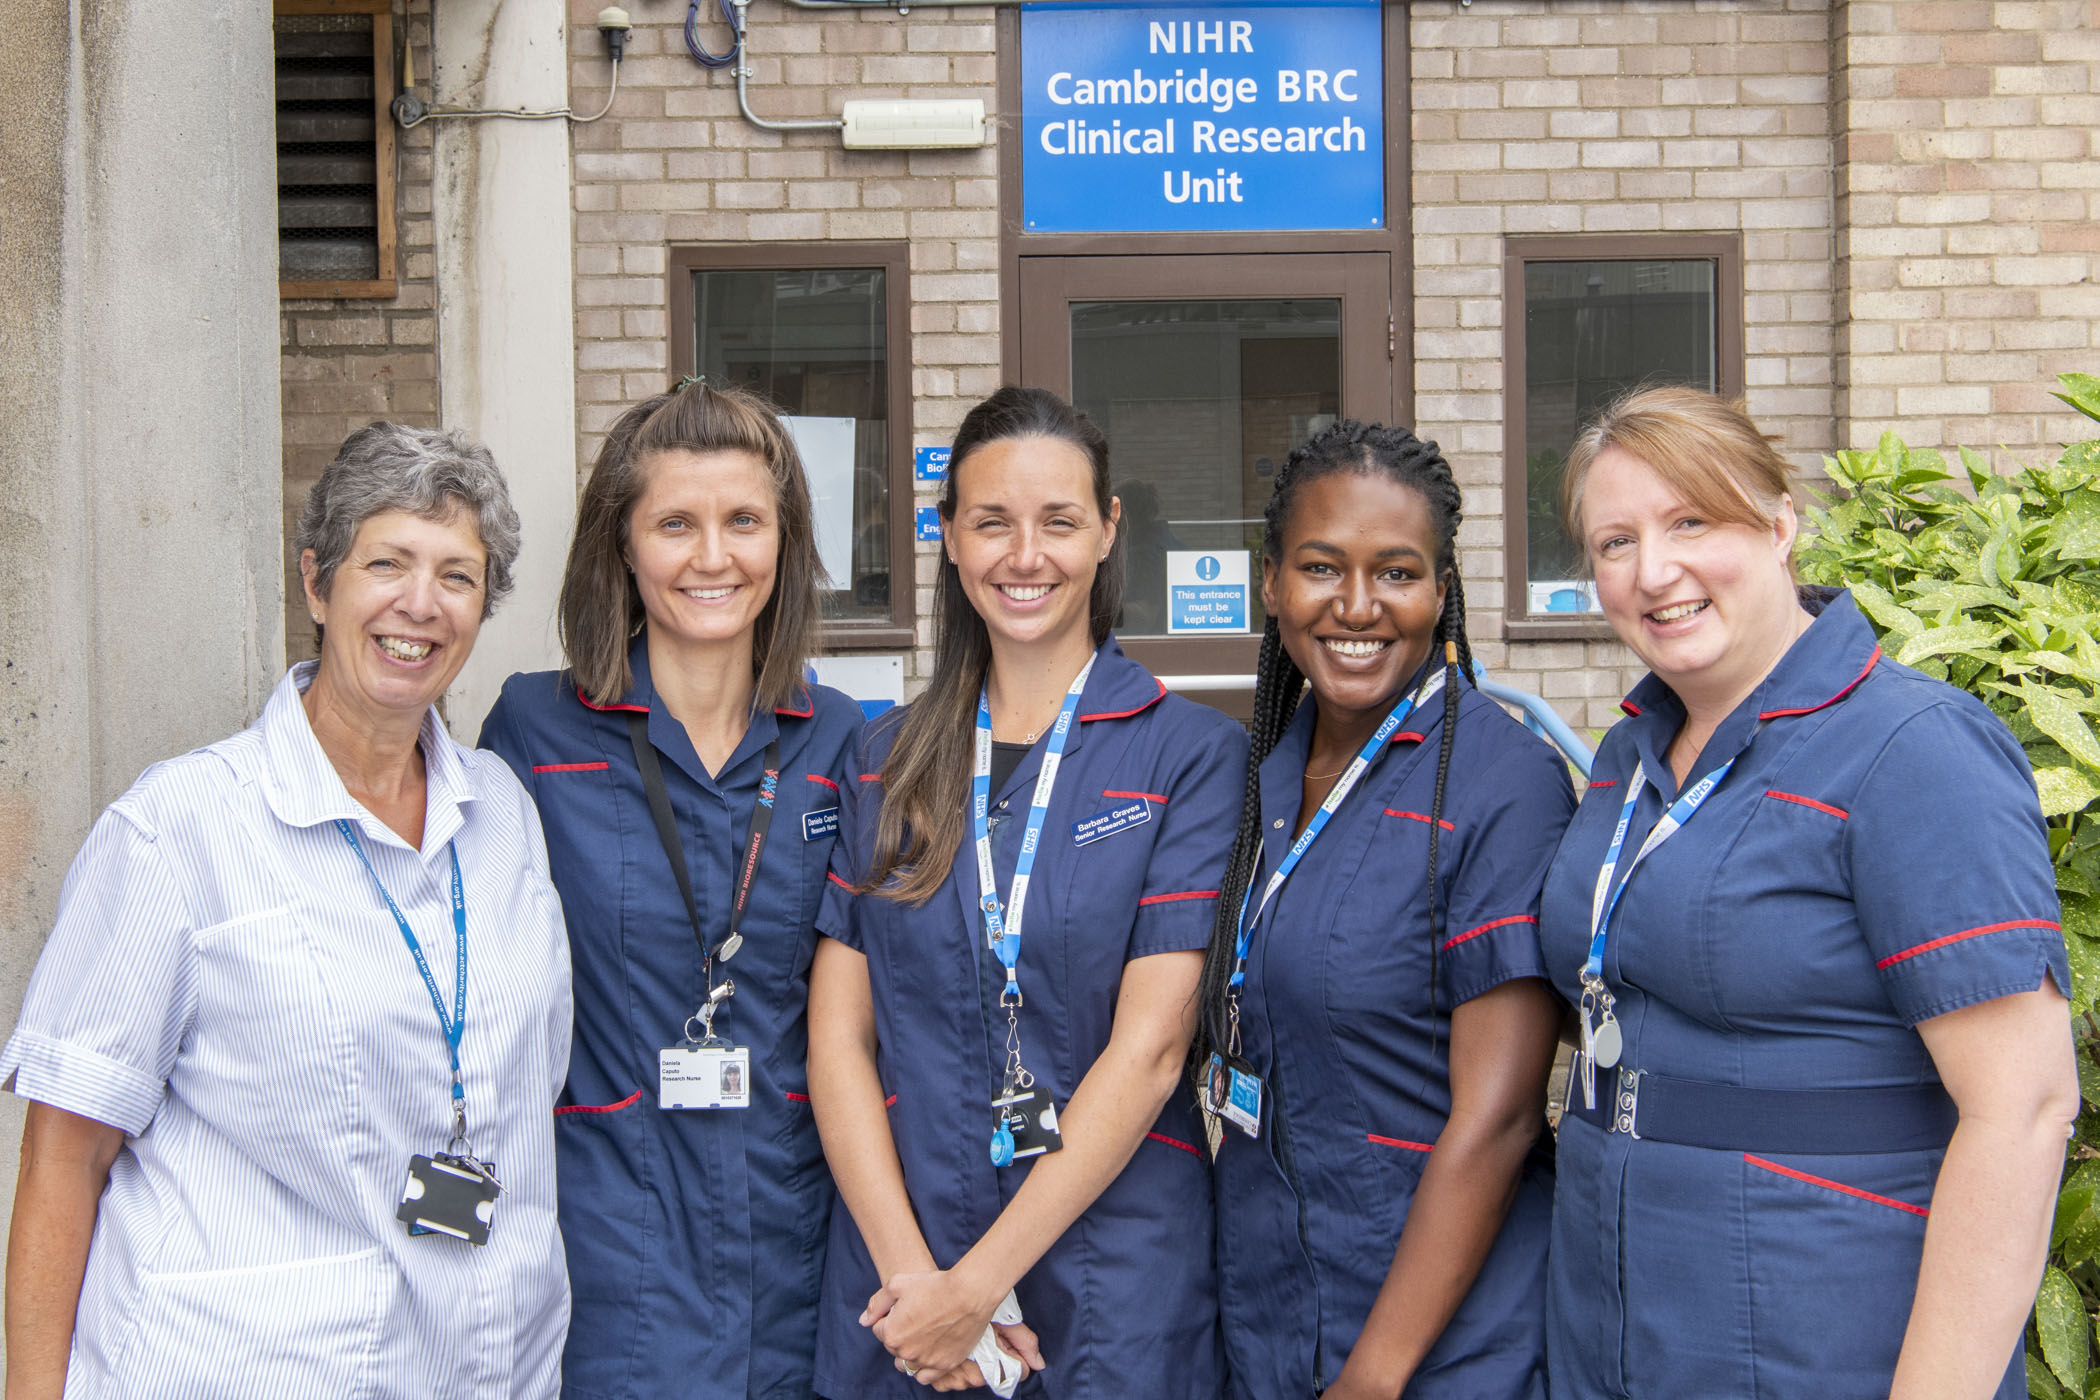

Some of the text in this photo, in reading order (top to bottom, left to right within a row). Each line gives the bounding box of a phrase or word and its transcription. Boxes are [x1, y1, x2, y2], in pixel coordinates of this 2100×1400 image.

[1149, 21, 1254, 54] NIHR
[1046, 68, 1359, 113] Cambridge BRC
[1040, 116, 1366, 155] Clinical Research
[1163, 168, 1244, 203] Unit
[1176, 590, 1241, 600] This entrance
[1188, 602, 1229, 611] must be
[1184, 615, 1234, 626] kept clear
[1057, 712, 1069, 732] NHS
[1376, 718, 1397, 740] NHS
[1688, 781, 1711, 804] NHS
[976, 796, 985, 817] NHS
[1077, 804, 1140, 832] Barbara Graves
[1075, 811, 1147, 841] Senior Research Nurse
[1614, 821, 1626, 844] NHS
[1024, 829, 1037, 852] NHS
[1293, 831, 1313, 854] NHS
[743, 832, 762, 888] BIORESOURCE
[457, 934, 465, 1021] www.actcharity.org.uk
[414, 948, 453, 1034] www.actcharity.org.uk
